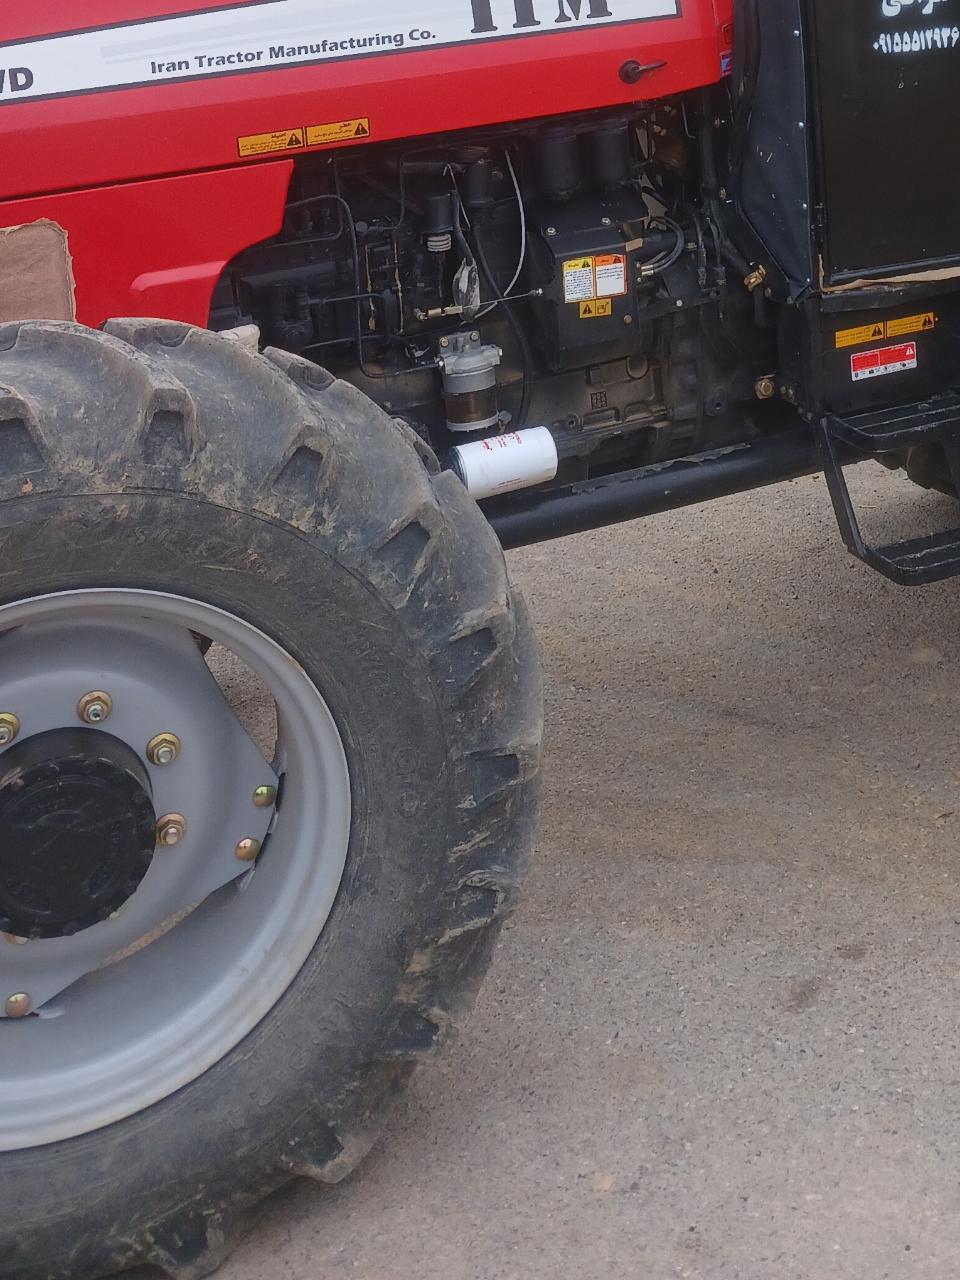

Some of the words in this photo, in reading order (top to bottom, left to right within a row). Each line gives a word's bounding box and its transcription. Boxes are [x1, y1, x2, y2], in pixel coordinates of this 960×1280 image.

[150, 60, 190, 74] Iran
[194, 51, 264, 68] Tractor
[269, 33, 404, 60] Manufacturing
[408, 28, 437, 41] Co.
